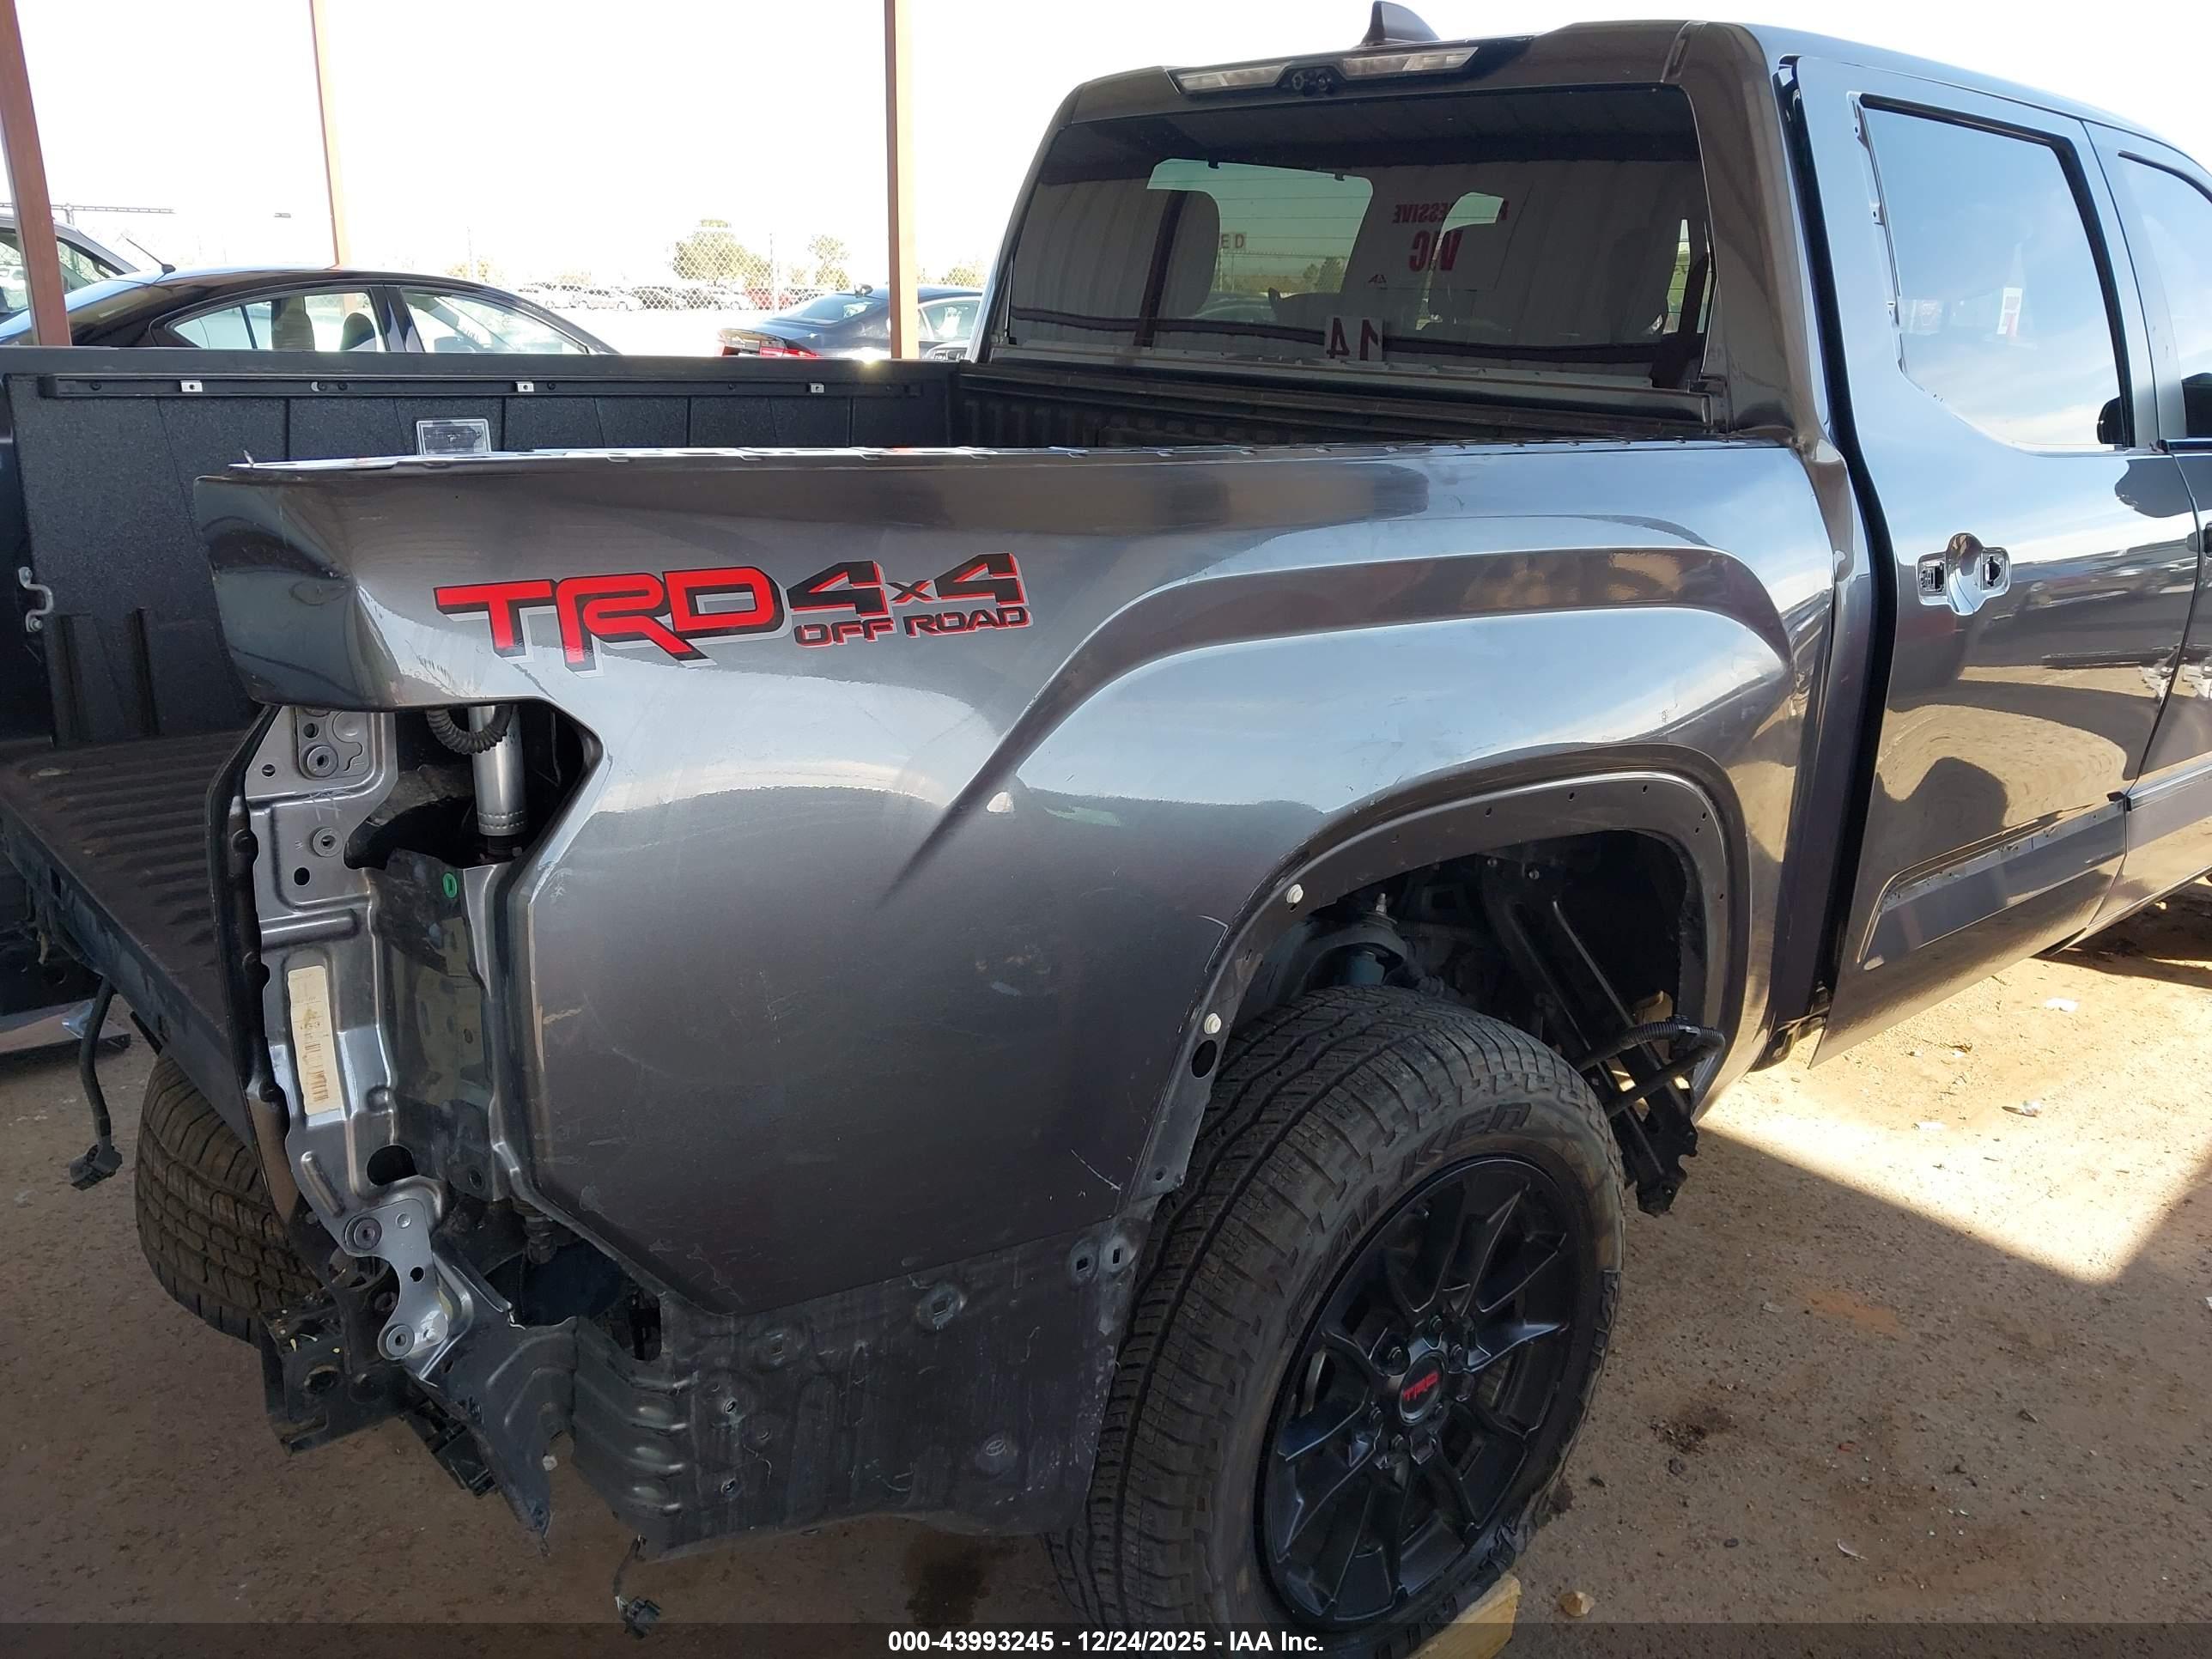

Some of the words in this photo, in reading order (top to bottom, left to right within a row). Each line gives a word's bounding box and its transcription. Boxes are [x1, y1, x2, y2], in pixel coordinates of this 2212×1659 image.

[434, 566, 788, 677] TRD
[793, 614, 895, 648] OFF
[903, 605, 1031, 638] ROAD
[1402, 1370, 1439, 1401] TRD
